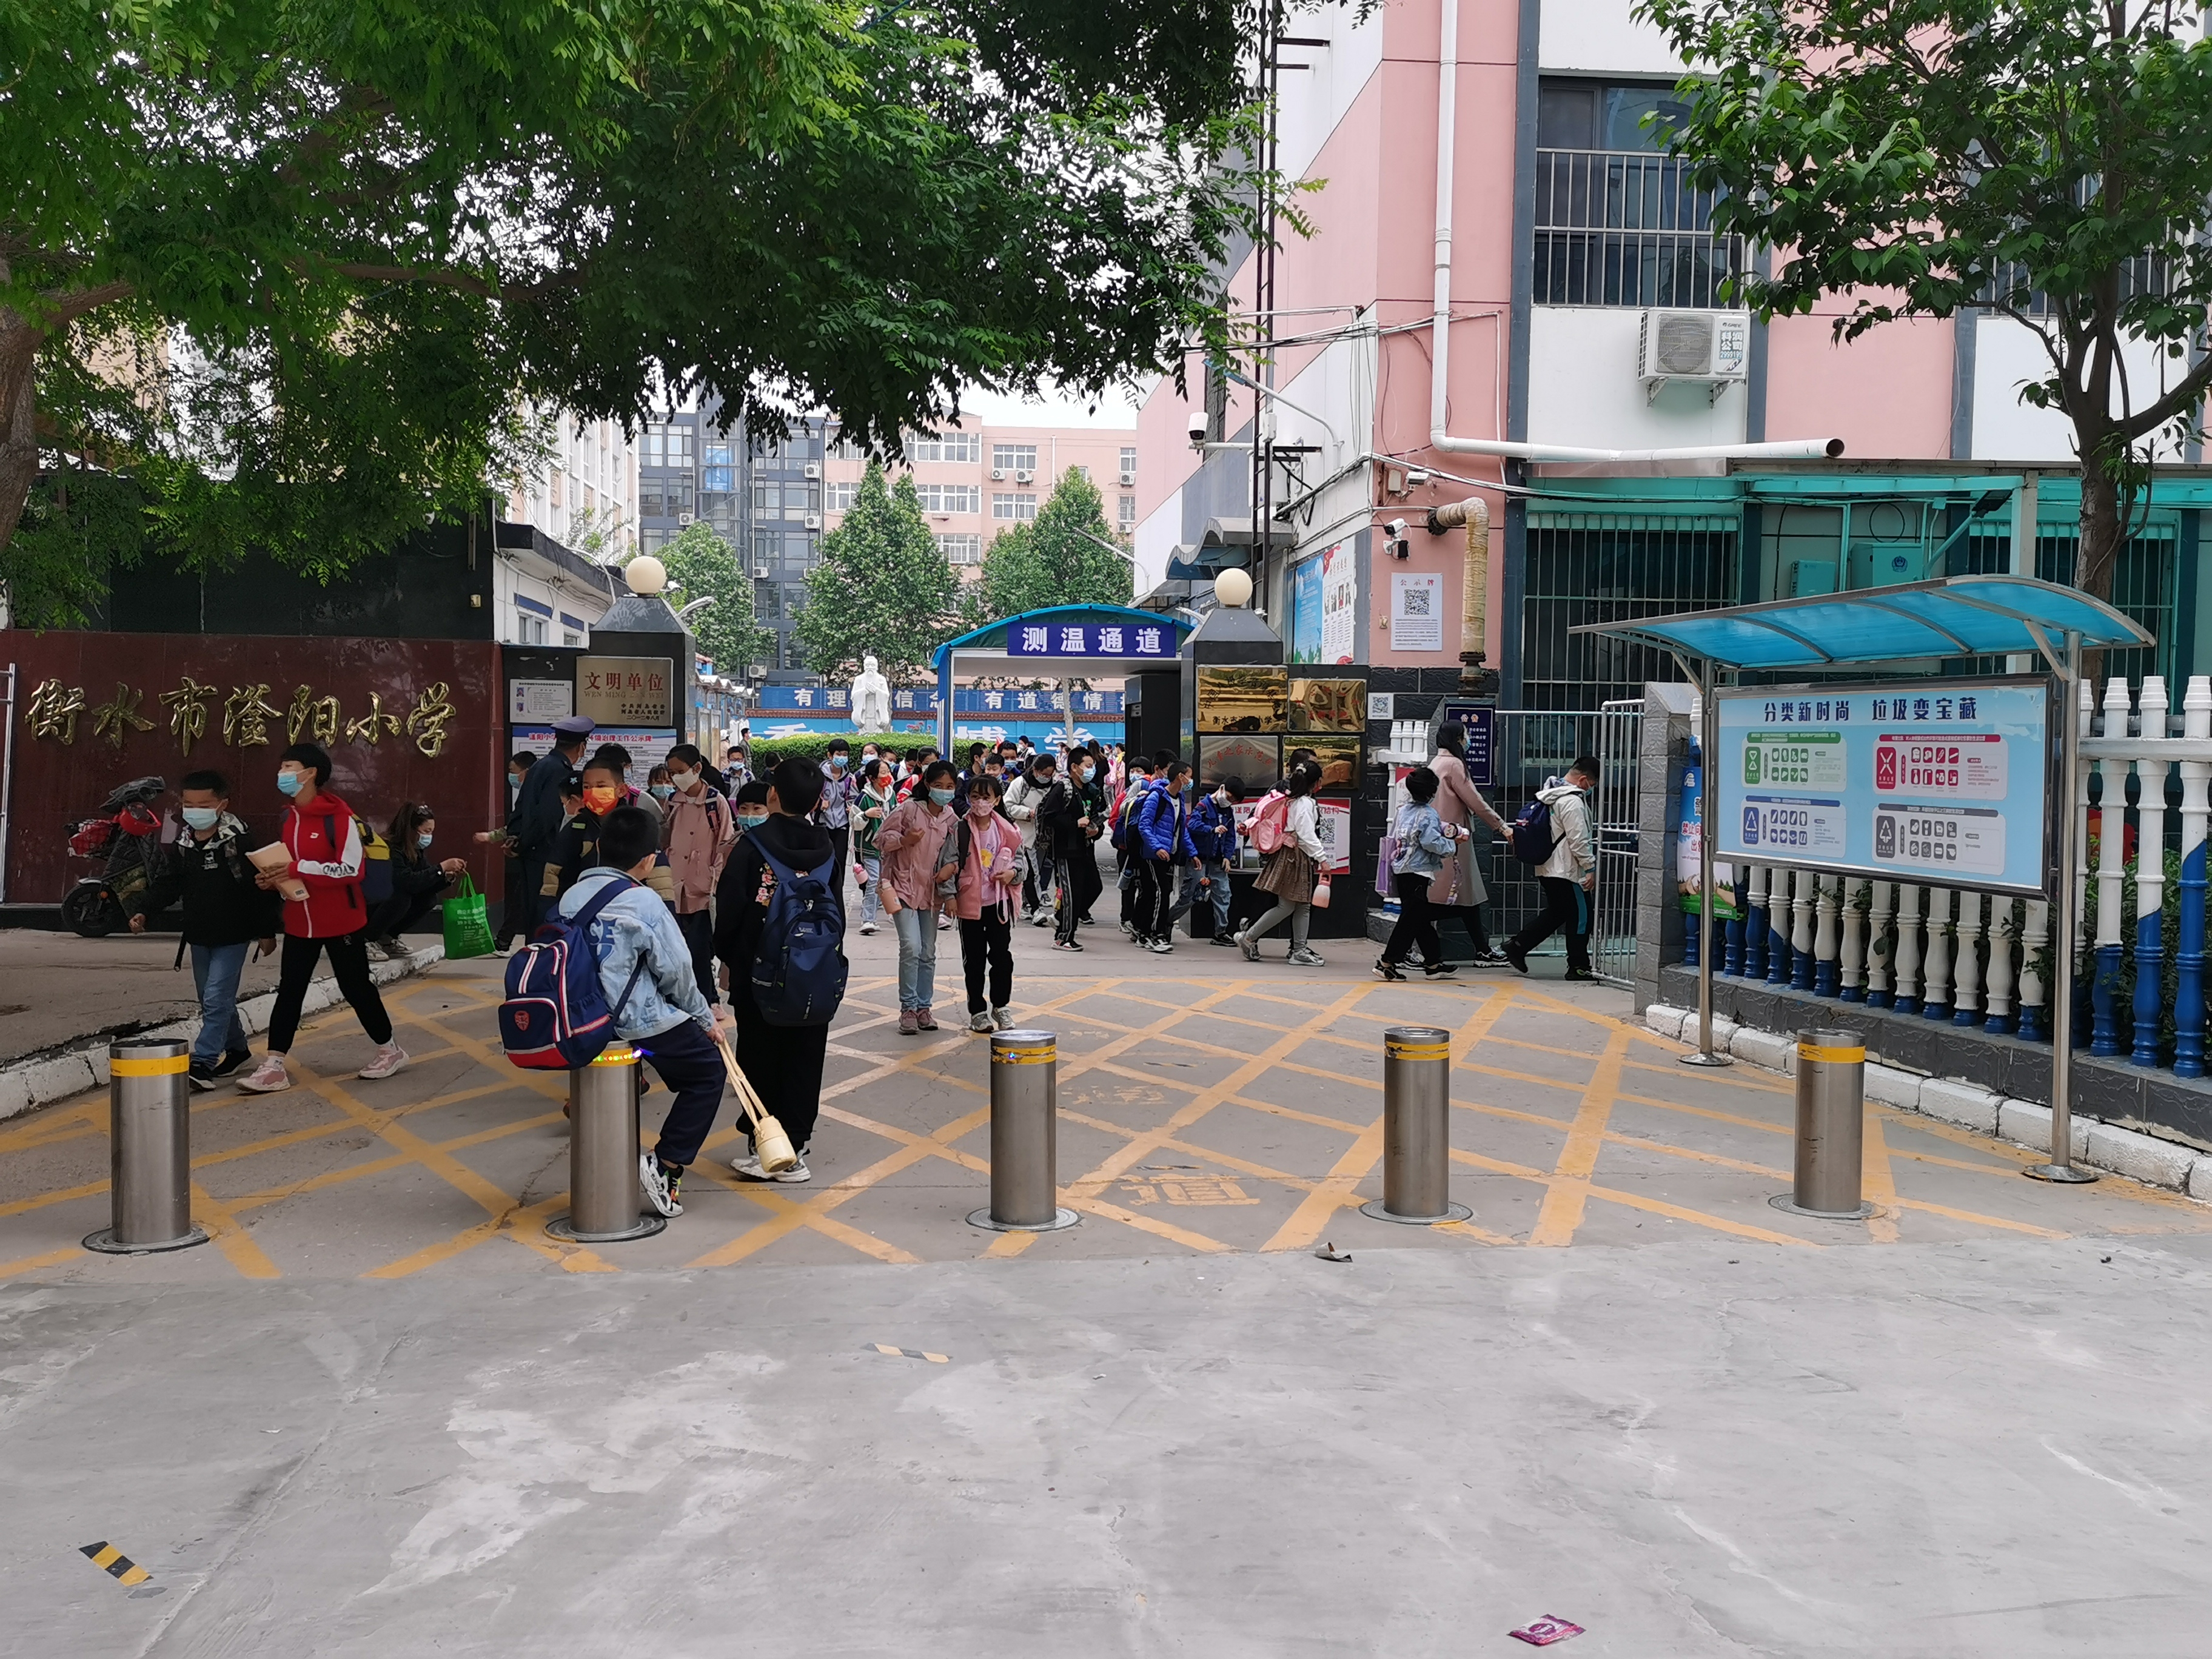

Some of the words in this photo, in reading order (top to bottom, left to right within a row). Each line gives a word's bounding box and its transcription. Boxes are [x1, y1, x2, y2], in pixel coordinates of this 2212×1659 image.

[1022, 626, 1161, 653] 测温通道
[585, 672, 663, 691] 文明单位
[794, 688, 938, 709] 有理信
[985, 691, 1125, 711] 有道德情
[1764, 700, 1849, 722] 分类新时尚
[1872, 697, 1977, 720] 垃圾变宝藏
